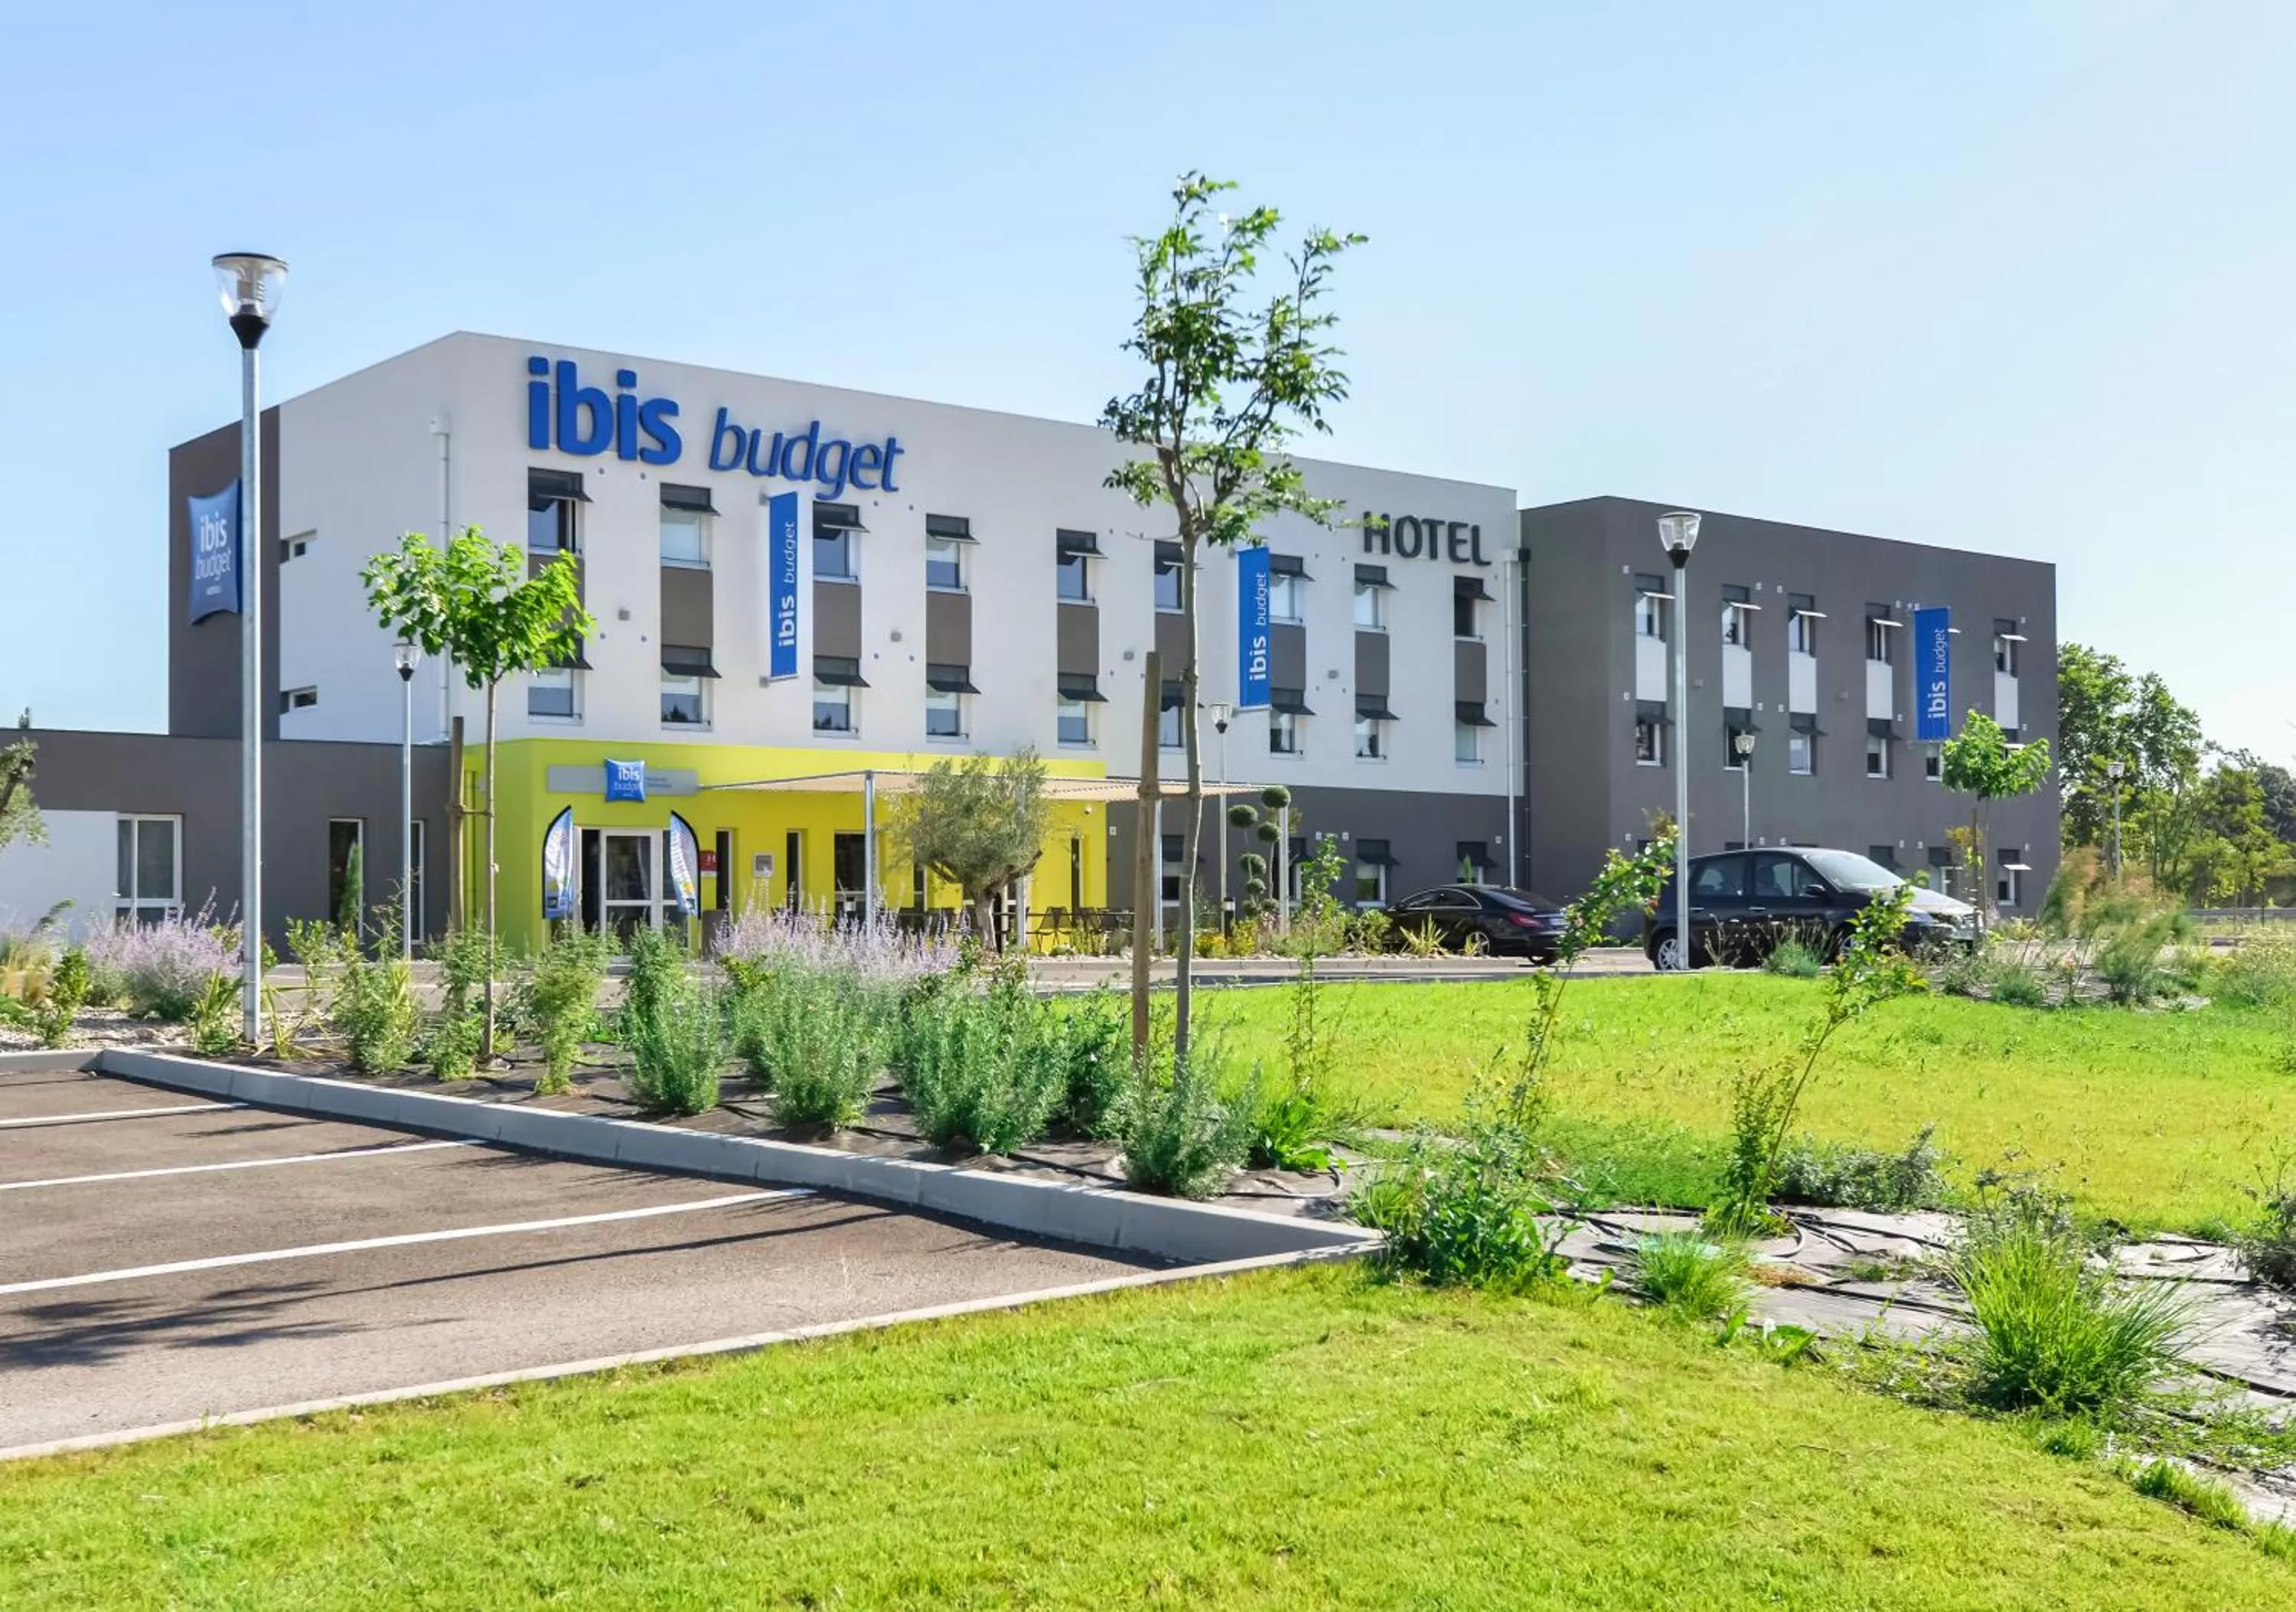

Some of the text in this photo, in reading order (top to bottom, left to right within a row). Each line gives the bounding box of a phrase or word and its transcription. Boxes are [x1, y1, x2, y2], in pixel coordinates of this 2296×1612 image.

[527, 357, 904, 500] ibis budget
[195, 547, 231, 580] budget
[200, 511, 227, 551] ibis
[1364, 511, 1492, 566] HOTEL
[778, 521, 796, 647] ibis budget
[1249, 573, 1267, 680] ibis budget
[1928, 629, 1947, 718] ibis budget
[618, 766, 640, 781] ibis
